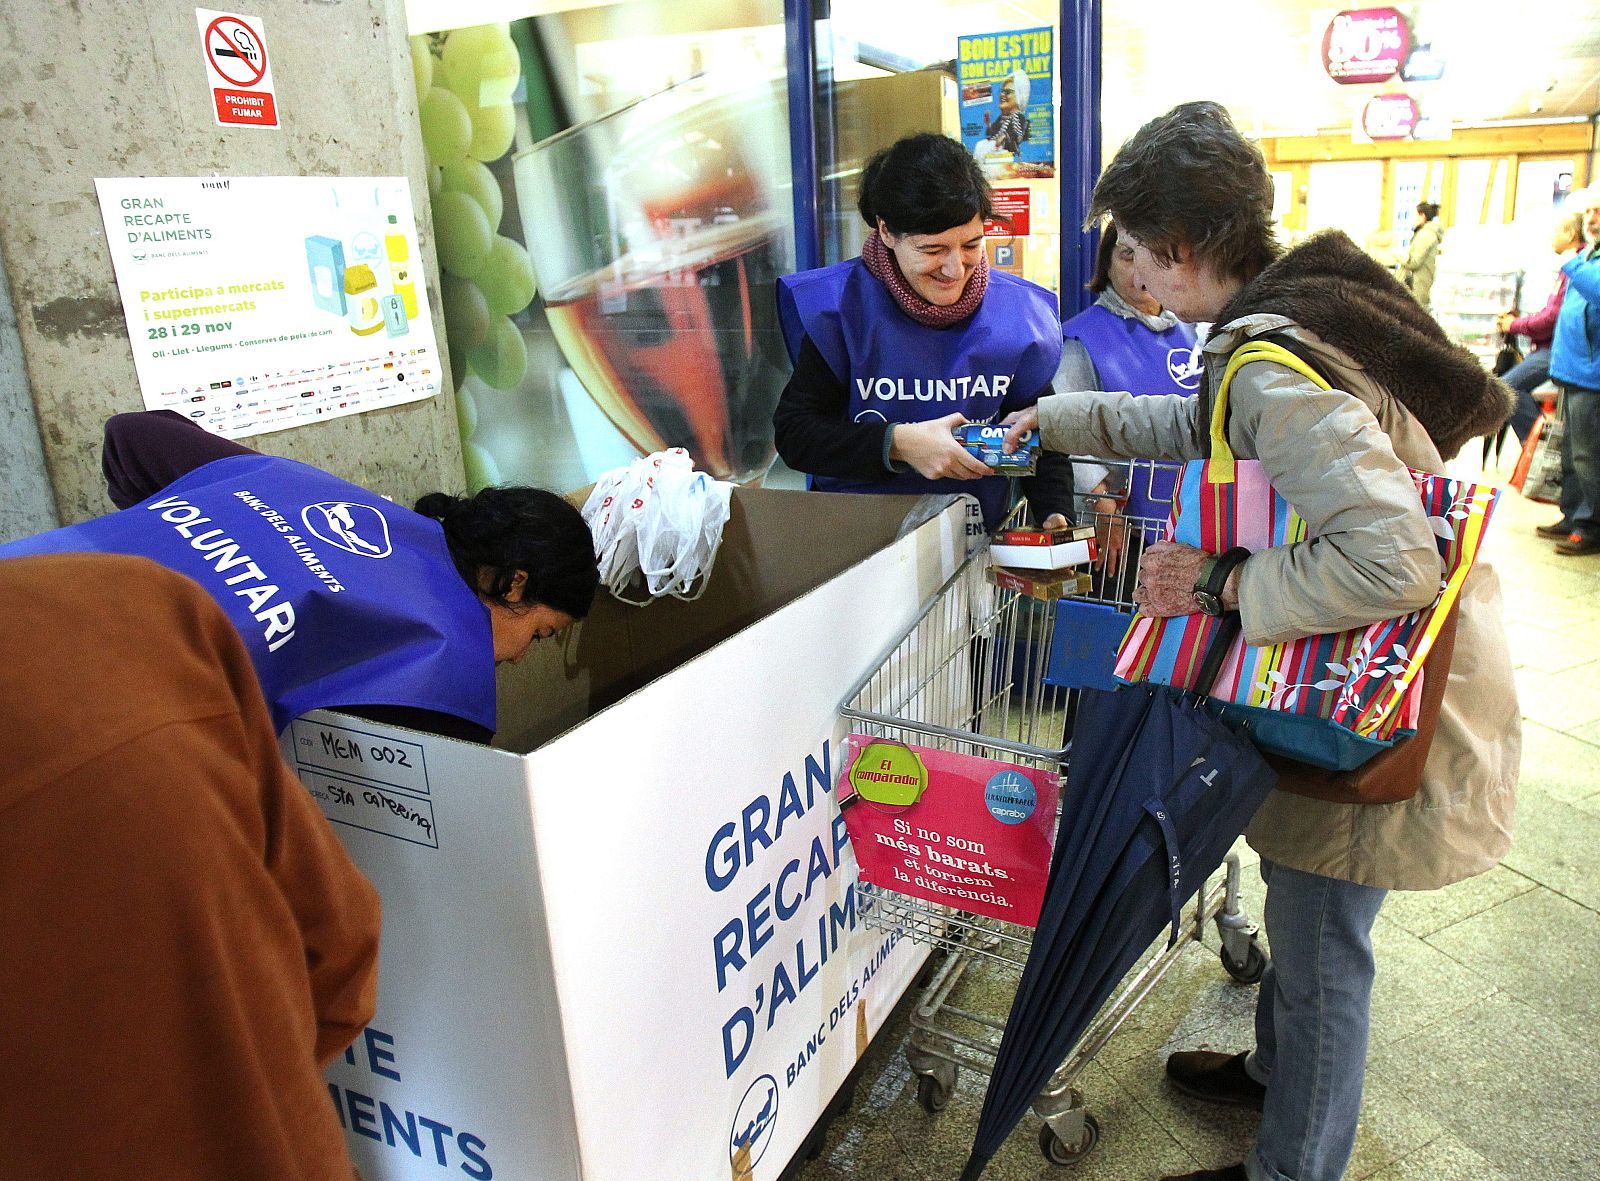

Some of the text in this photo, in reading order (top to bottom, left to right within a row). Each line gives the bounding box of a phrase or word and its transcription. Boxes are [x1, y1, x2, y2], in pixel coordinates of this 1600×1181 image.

[960, 31, 1051, 61] BON ESTIU
[961, 62, 985, 78] BON
[985, 60, 1011, 76] CAP
[225, 96, 264, 106] PROHIBIT
[232, 108, 262, 117] FUMAR
[120, 198, 164, 210] GRAN
[124, 213, 192, 226] RECAPTE
[128, 229, 212, 243] D'ALIMENTS
[998, 247, 1011, 264] P
[140, 279, 286, 302] Participa a mercats
[144, 300, 257, 321] i supermercats
[147, 321, 233, 340] 28 i 29 nov
[152, 350, 165, 358] Oli
[172, 348, 190, 356] Llet
[196, 342, 233, 352] Llegums
[239, 337, 277, 347] Conserves
[233, 490, 346, 593] BANC DELS ALIMENTS
[147, 495, 296, 653] VOLUNTARI
[320, 732, 412, 768] MEM 002
[880, 759, 891, 771] El
[856, 770, 919, 786] comparador
[705, 738, 831, 892] GRAN
[893, 818, 986, 855] Si no som
[874, 832, 1016, 882] més barats.
[904, 856, 995, 888] et tornem
[893, 867, 1014, 908] la diferència.
[786, 1023, 826, 1088] BANC
[830, 979, 859, 1031] DELS
